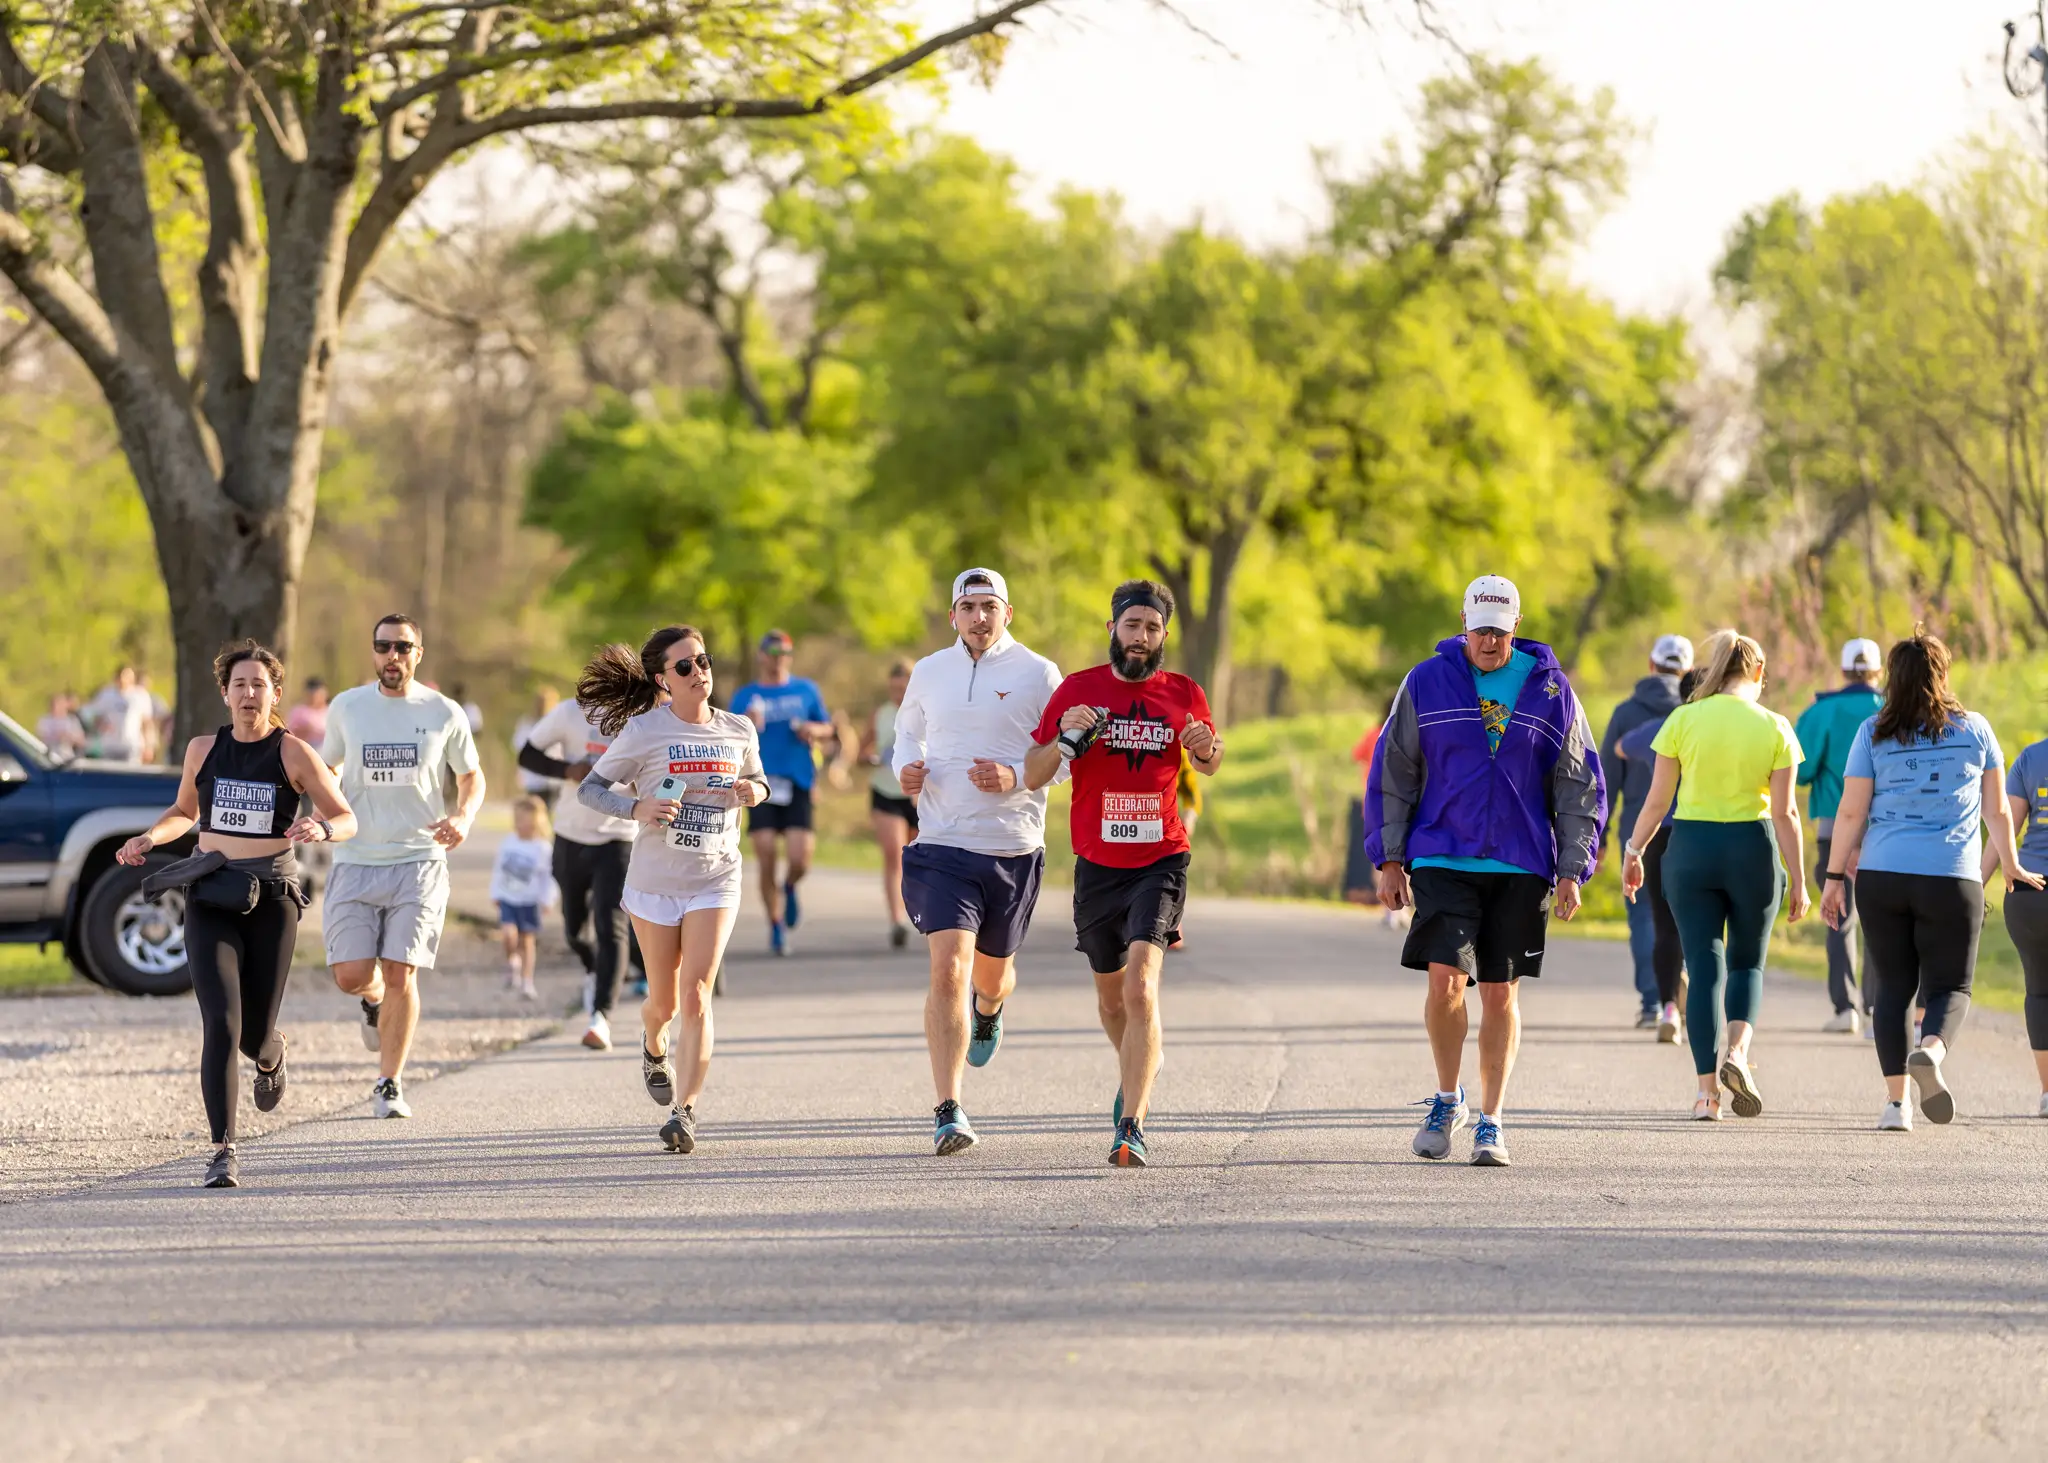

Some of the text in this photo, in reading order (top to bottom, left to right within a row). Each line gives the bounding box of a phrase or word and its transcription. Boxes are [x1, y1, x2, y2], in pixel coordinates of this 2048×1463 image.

[1473, 591, 1510, 604] VIKINGS
[1101, 724, 1175, 743] CHICAGO
[1112, 740, 1162, 751] MARATHON
[673, 764, 735, 772] WHITE ROCK
[371, 771, 393, 782] 411
[246, 803, 269, 811] ROCK
[219, 811, 247, 827] 489
[674, 822, 720, 834] WHITE ROCK
[1110, 824, 1138, 838] 809
[675, 832, 701, 848] 265
[1144, 829, 1160, 840] 10K
